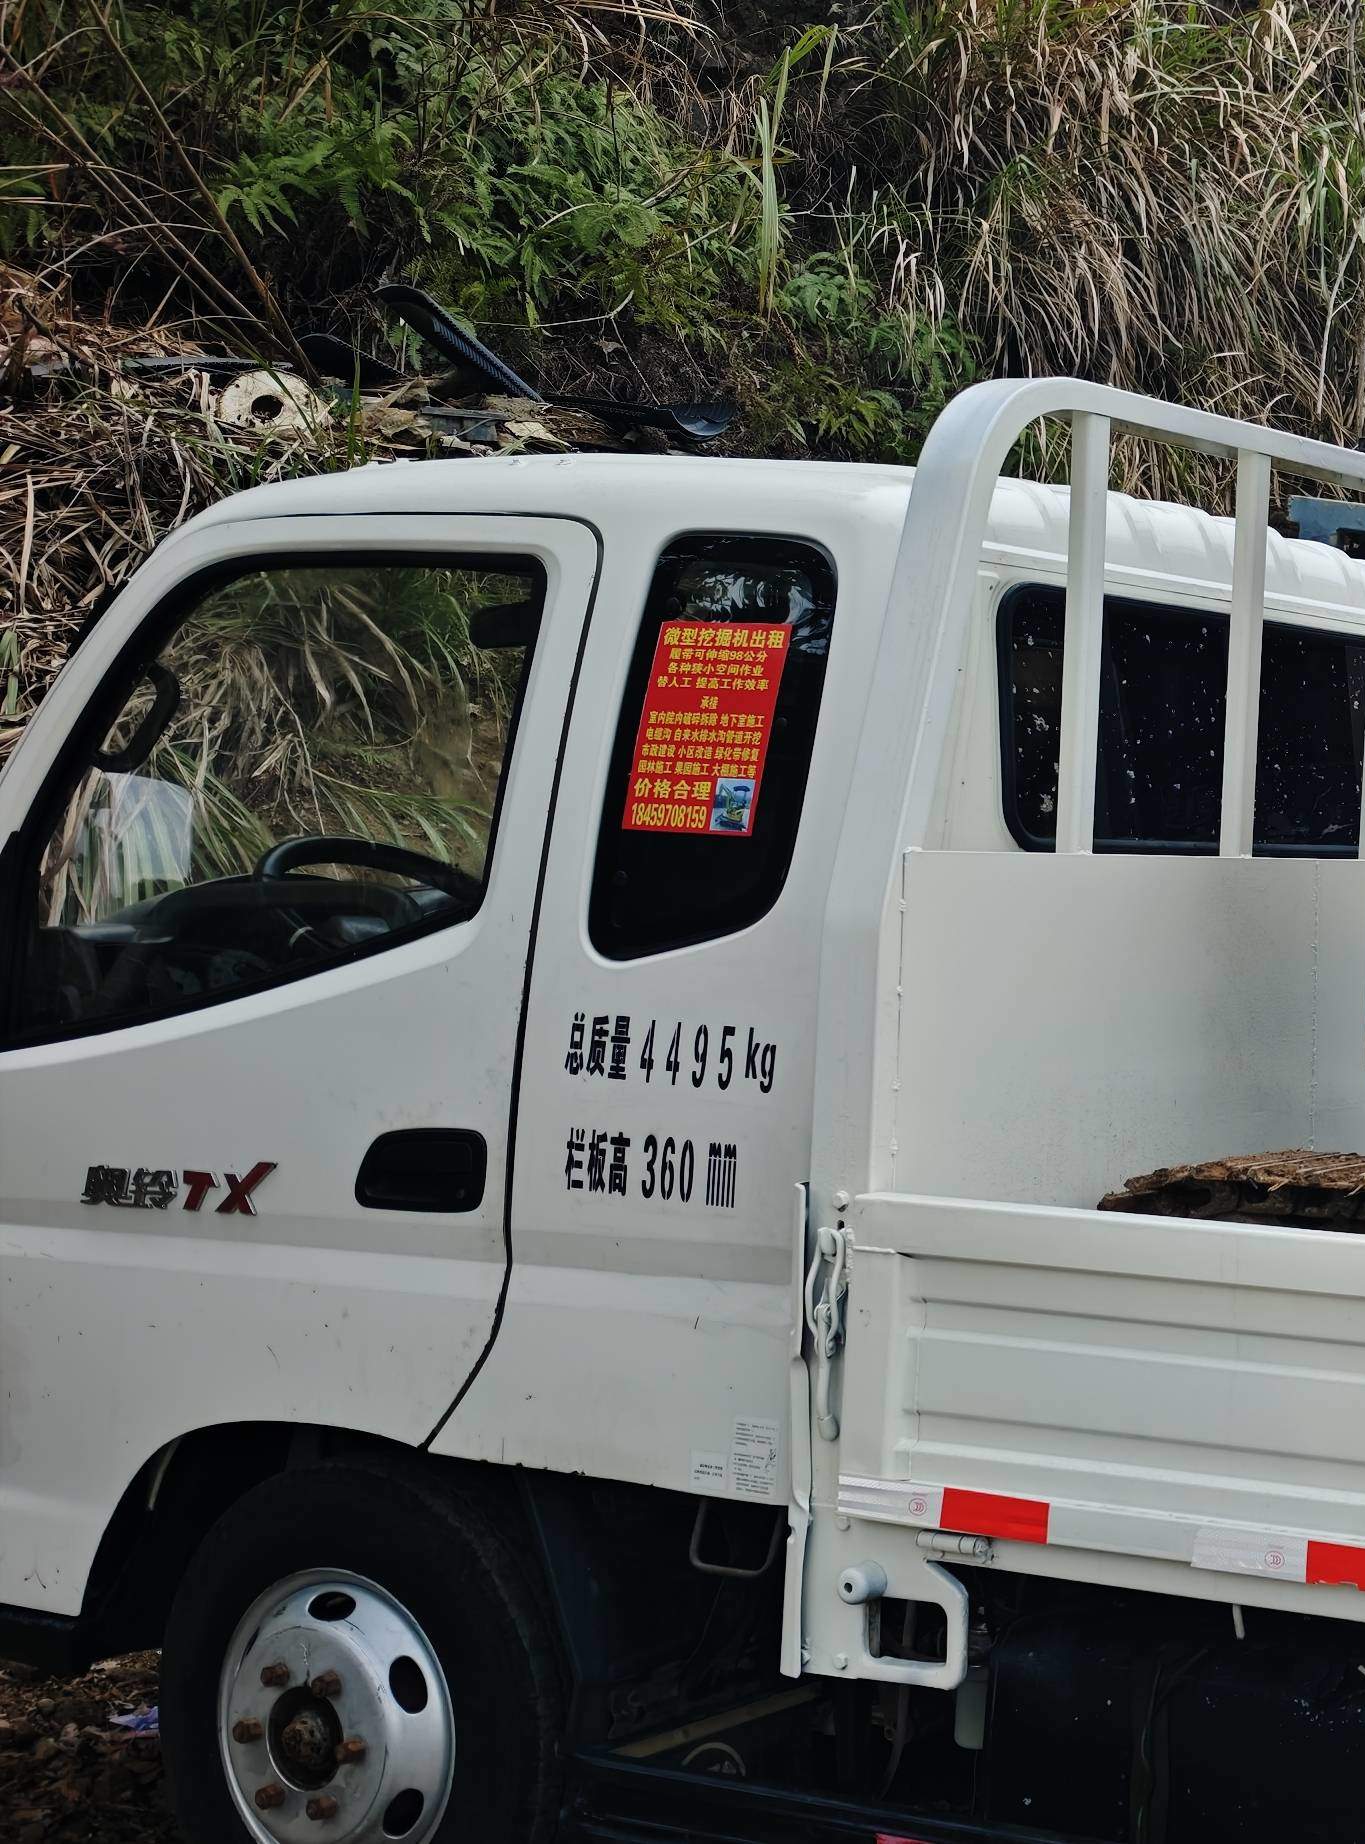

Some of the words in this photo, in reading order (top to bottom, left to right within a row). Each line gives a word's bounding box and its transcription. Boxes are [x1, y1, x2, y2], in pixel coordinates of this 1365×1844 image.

[664, 627, 785, 648] 微型挖掘机出租
[634, 778, 712, 801] 价格合理
[631, 802, 708, 829] 18459708159
[564, 1012, 631, 1081] 总质量
[639, 1019, 736, 1091] 4495
[744, 1026, 777, 1094] kg
[565, 1127, 631, 1197] 栏板高
[641, 1134, 695, 1203] 360
